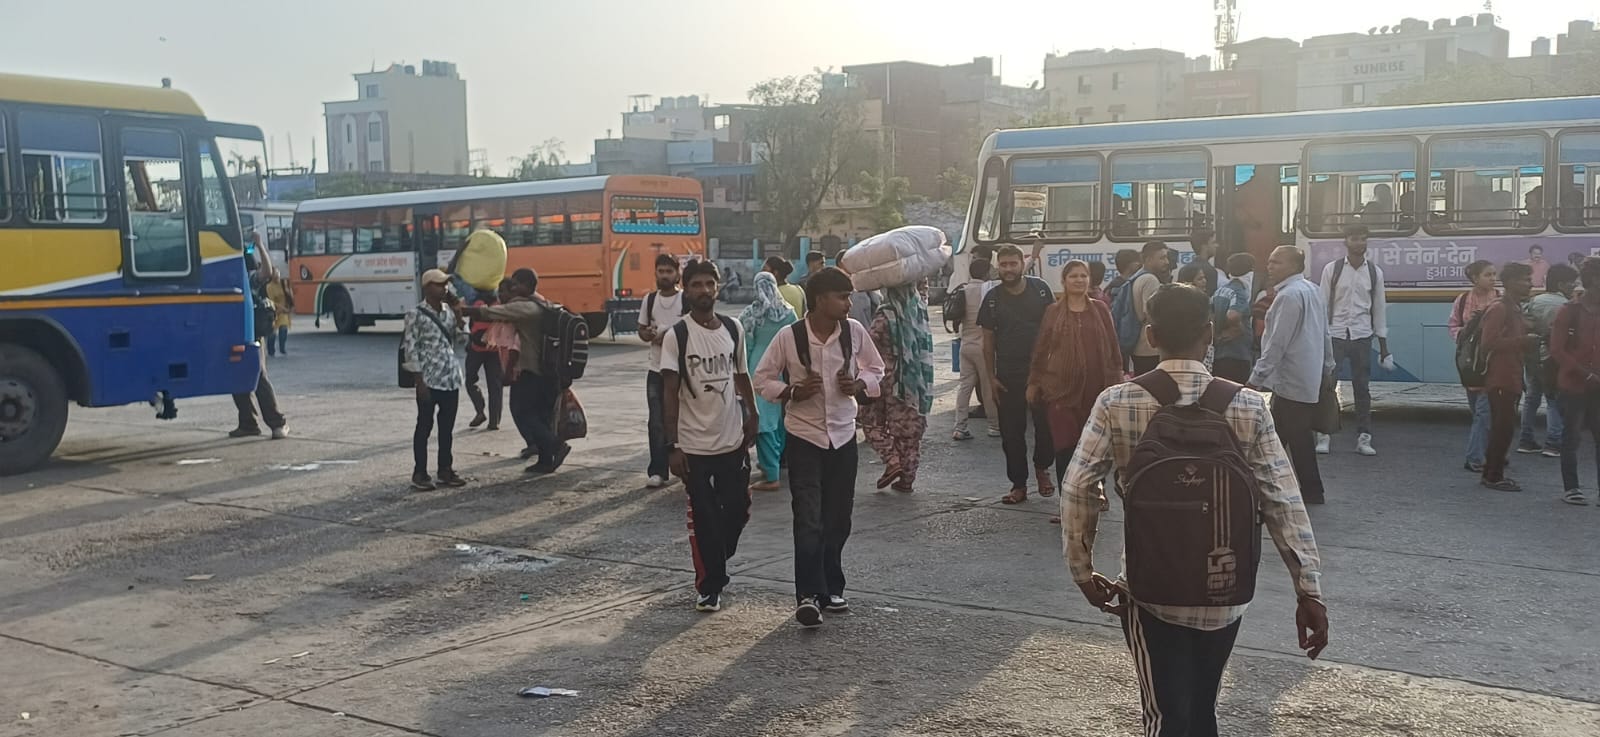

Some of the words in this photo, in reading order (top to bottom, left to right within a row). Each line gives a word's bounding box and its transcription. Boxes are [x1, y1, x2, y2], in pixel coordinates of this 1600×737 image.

[1353, 60, 1406, 74] SUNRISE
[1382, 241, 1401, 265] से
[1404, 241, 1478, 265] लेन-देन
[1426, 266, 1447, 280] हुआ
